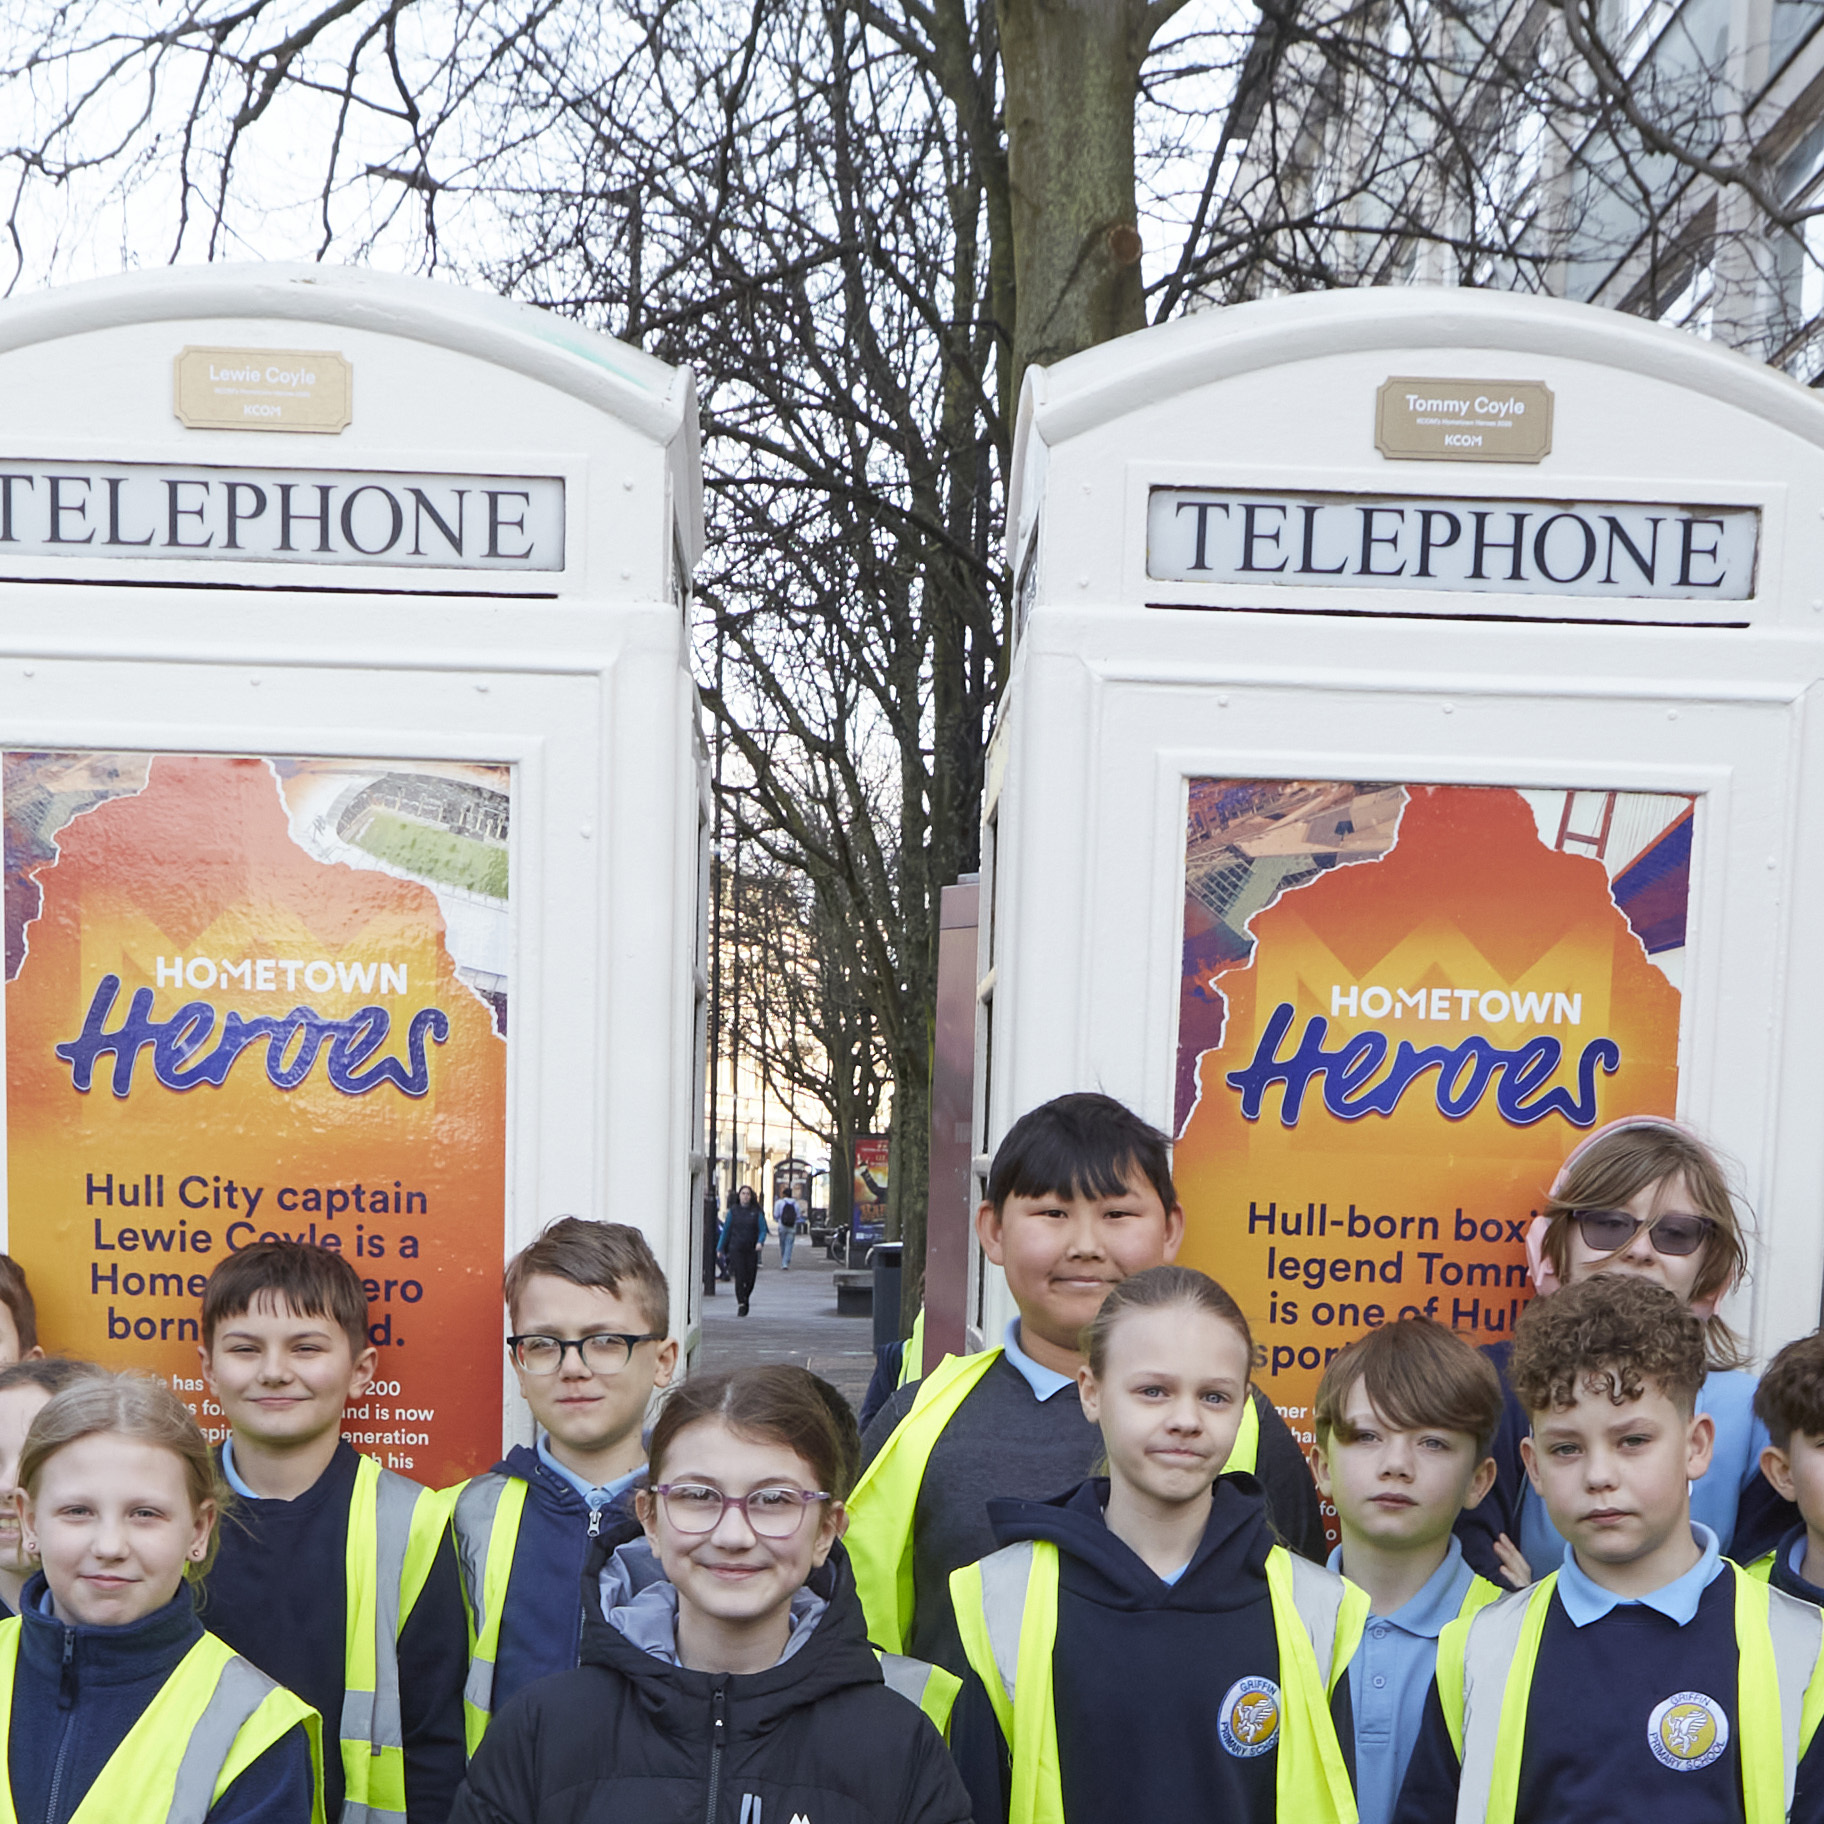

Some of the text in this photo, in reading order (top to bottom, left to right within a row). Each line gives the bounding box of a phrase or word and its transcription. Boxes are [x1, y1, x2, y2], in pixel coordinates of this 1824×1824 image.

[209, 364, 316, 388] Lewie Coyle
[243, 404, 282, 417] KCOM
[1405, 394, 1525, 418] Tommy Coyle
[1444, 434, 1484, 448] KCOM
[1176, 501, 1727, 590] TELEPHONE
[156, 956, 408, 995] HOMETOWN
[1330, 985, 1582, 1025] HOMETOWN
[54, 973, 450, 1099] Heroes
[1225, 1002, 1620, 1128] Heroes
[85, 1173, 428, 1220] Hull City captain
[94, 1218, 213, 1254] Lewie
[355, 1224, 386, 1259] is
[398, 1235, 420, 1259] a
[1248, 1202, 1440, 1241] Hull-born
[1267, 1246, 1404, 1290] legend
[107, 1306, 199, 1342] born
[1269, 1290, 1299, 1326] is
[1311, 1301, 1386, 1328] one
[1398, 1296, 1440, 1324] of
[1253, 1341, 1354, 1377] spor
[173, 1373, 205, 1392] has
[364, 1379, 402, 1397] 200
[201, 1399, 227, 1417] fo
[374, 1404, 390, 1421] is
[394, 1408, 435, 1422] now
[388, 1452, 415, 1470] his
[1239, 1679, 1277, 1696] GRIFFIN
[1669, 1692, 1712, 1707] GRIFFIN
[1220, 1721, 1249, 1757] PRIMARY
[1649, 1731, 1726, 1770] PRIMARY SCHOOL
